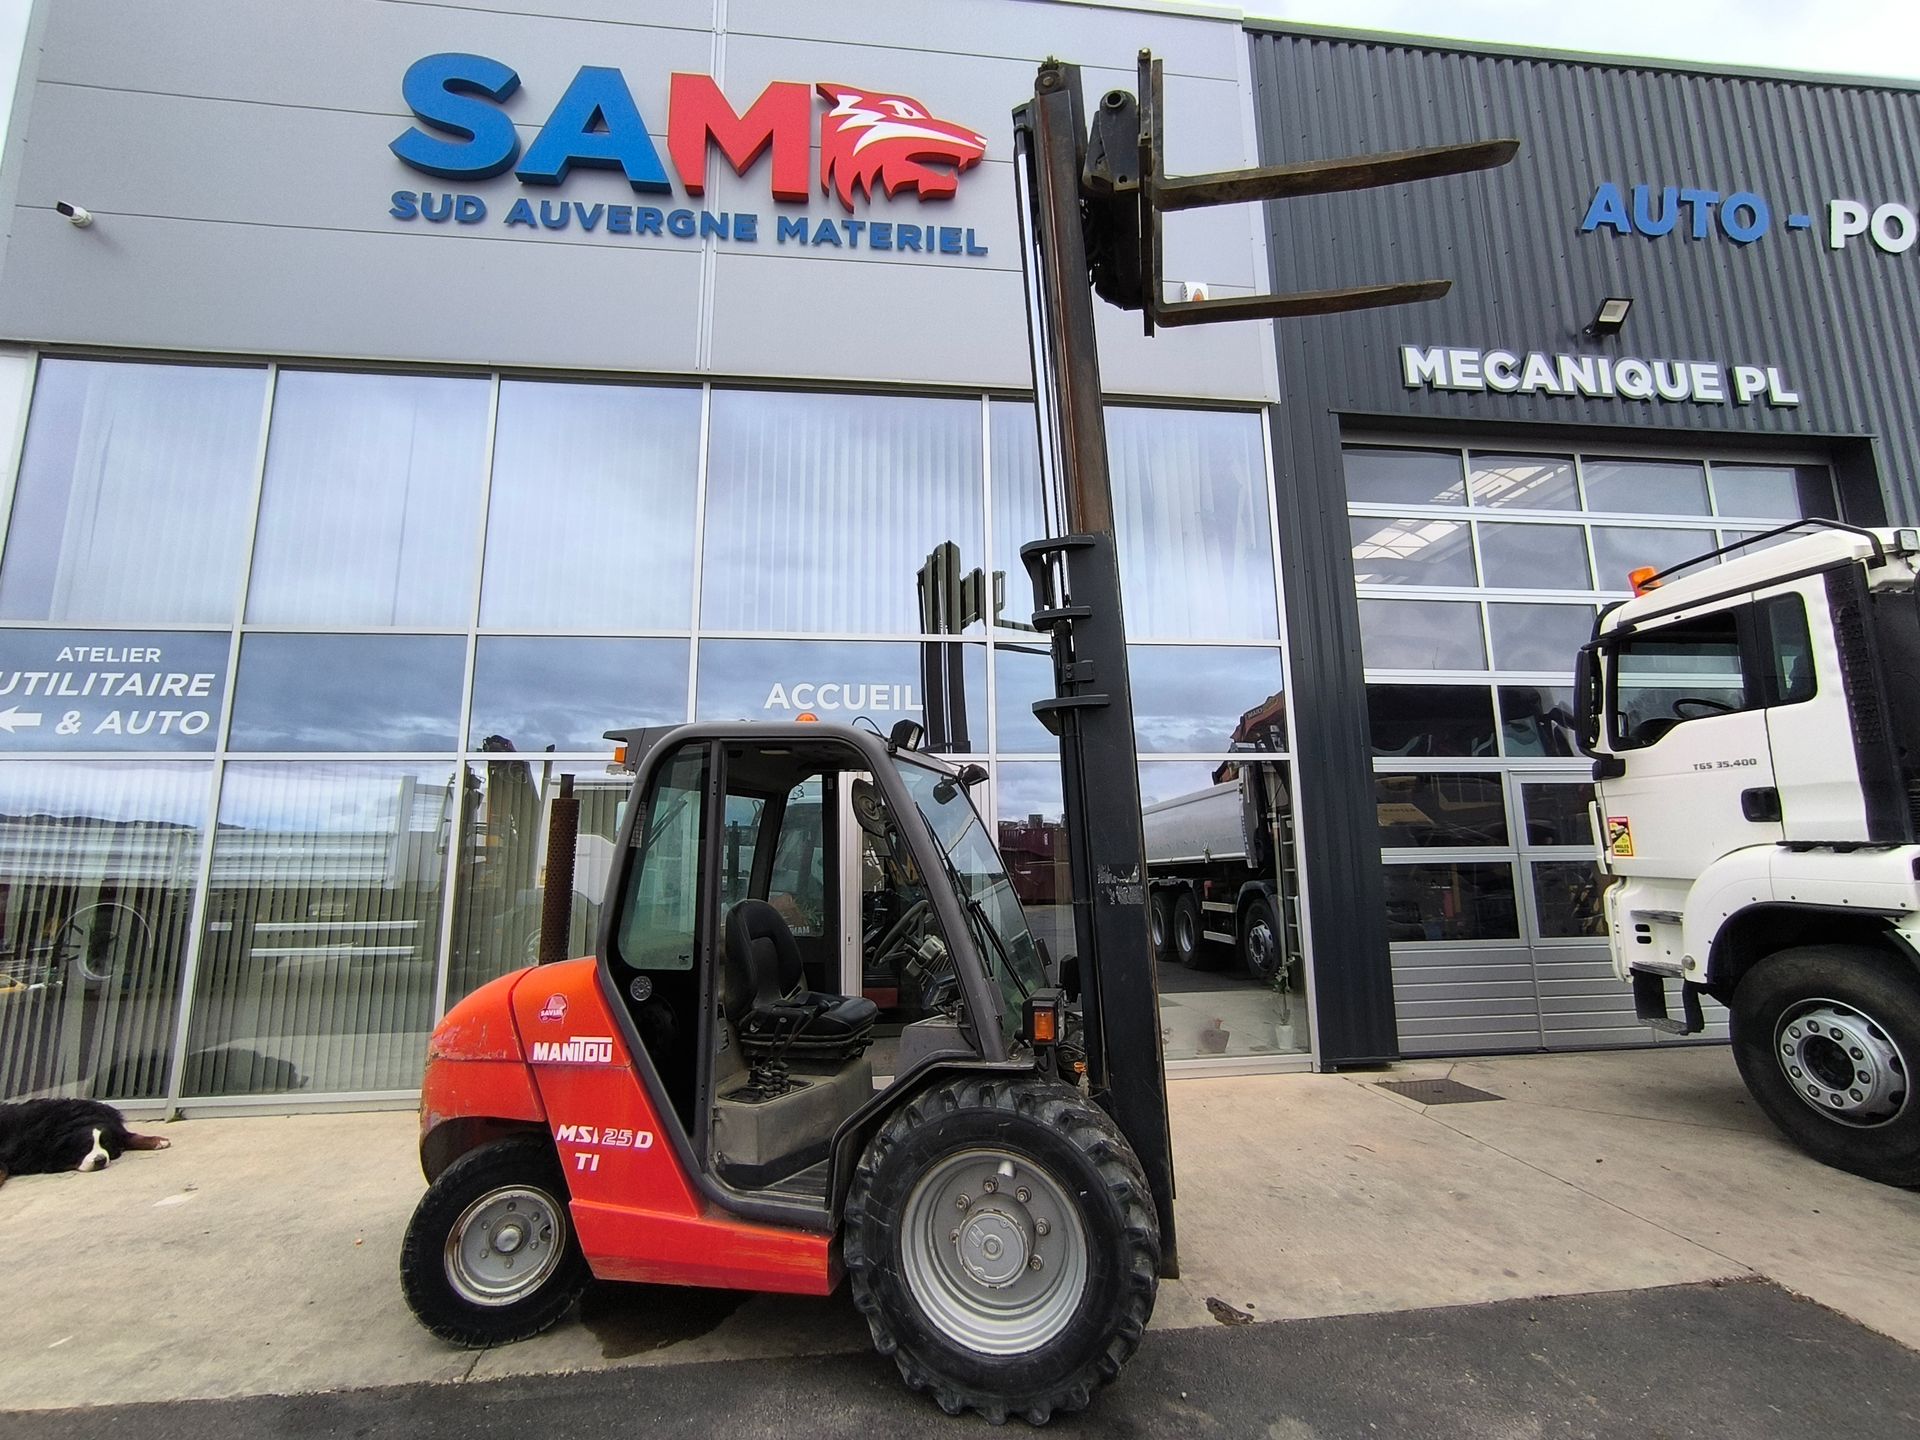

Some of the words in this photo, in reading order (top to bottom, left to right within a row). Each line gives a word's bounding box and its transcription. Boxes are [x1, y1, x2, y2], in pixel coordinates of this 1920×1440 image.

[389, 52, 811, 202] SAM
[389, 190, 487, 223] SUD
[504, 198, 759, 242] AUVERGNE
[776, 215, 989, 255] MATERIEL
[1581, 182, 1770, 243] AUTO
[1401, 345, 1727, 404] MECANIQUE
[1733, 365, 1799, 405] PL
[56, 646, 162, 663] ATELIER
[0, 671, 216, 697] UTILITAIRE
[763, 682, 924, 711] ACCUEIL
[54, 710, 82, 735] &
[92, 710, 210, 735] AUTO
[1693, 761, 1713, 770] TGS
[1716, 758, 1758, 768] 35.400
[533, 1036, 613, 1063] MANITOU
[575, 1153, 600, 1171] TI
